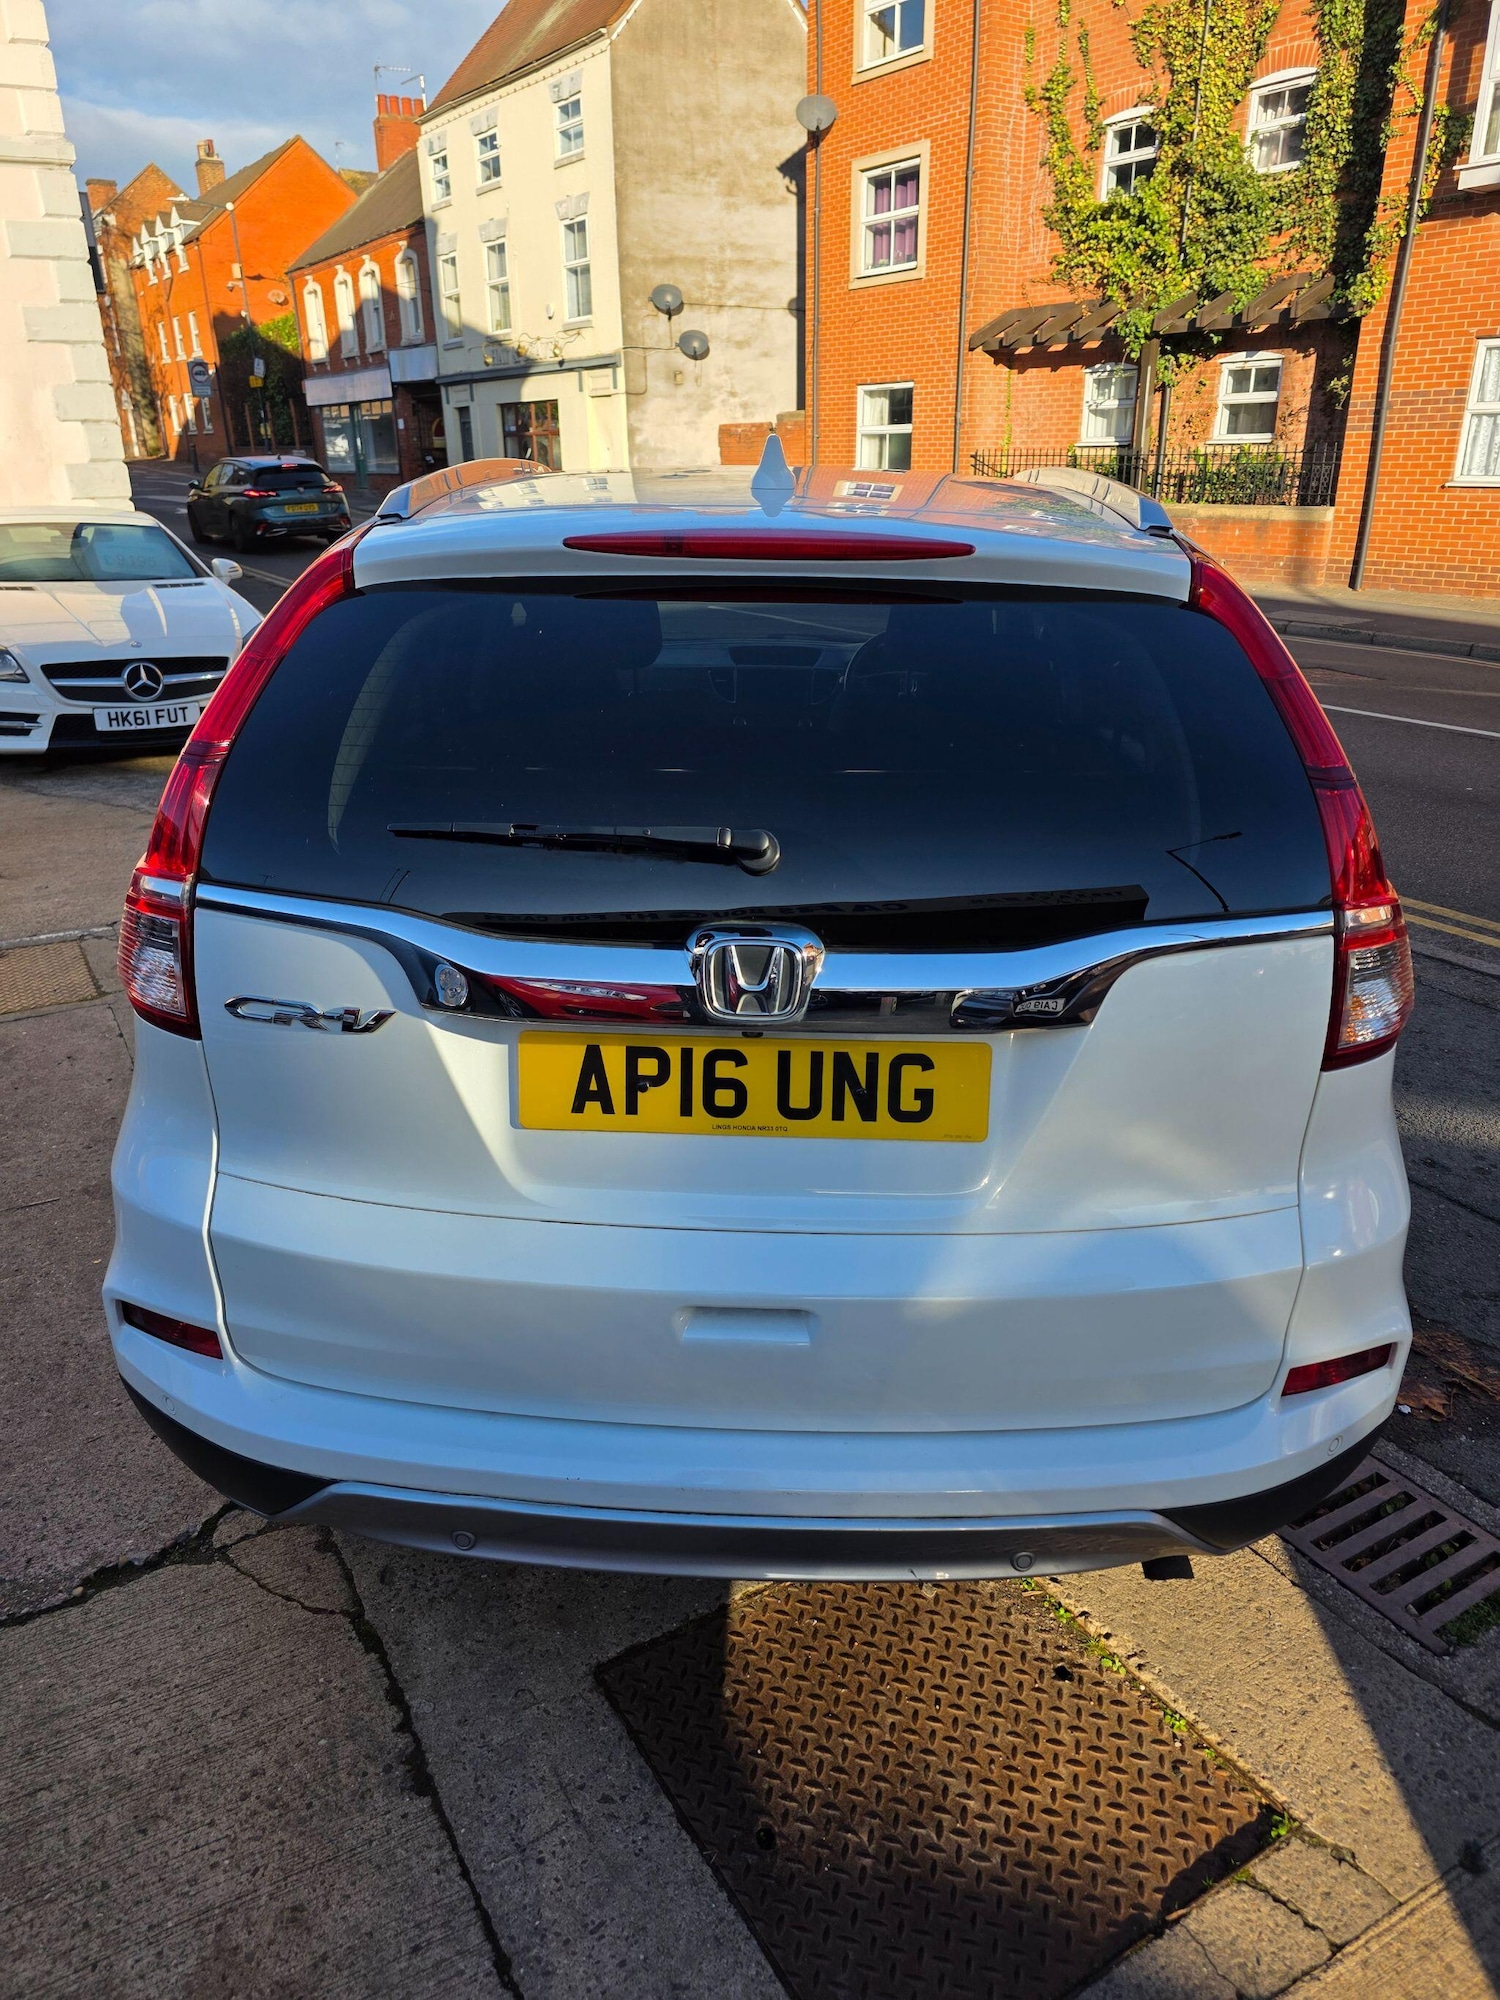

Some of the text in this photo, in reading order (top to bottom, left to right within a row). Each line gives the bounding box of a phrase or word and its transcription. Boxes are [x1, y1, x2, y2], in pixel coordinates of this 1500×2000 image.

[107, 706, 188, 728] HK61 FUT
[224, 993, 397, 1033] CR-V
[570, 1043, 935, 1123] AP16 UNG
